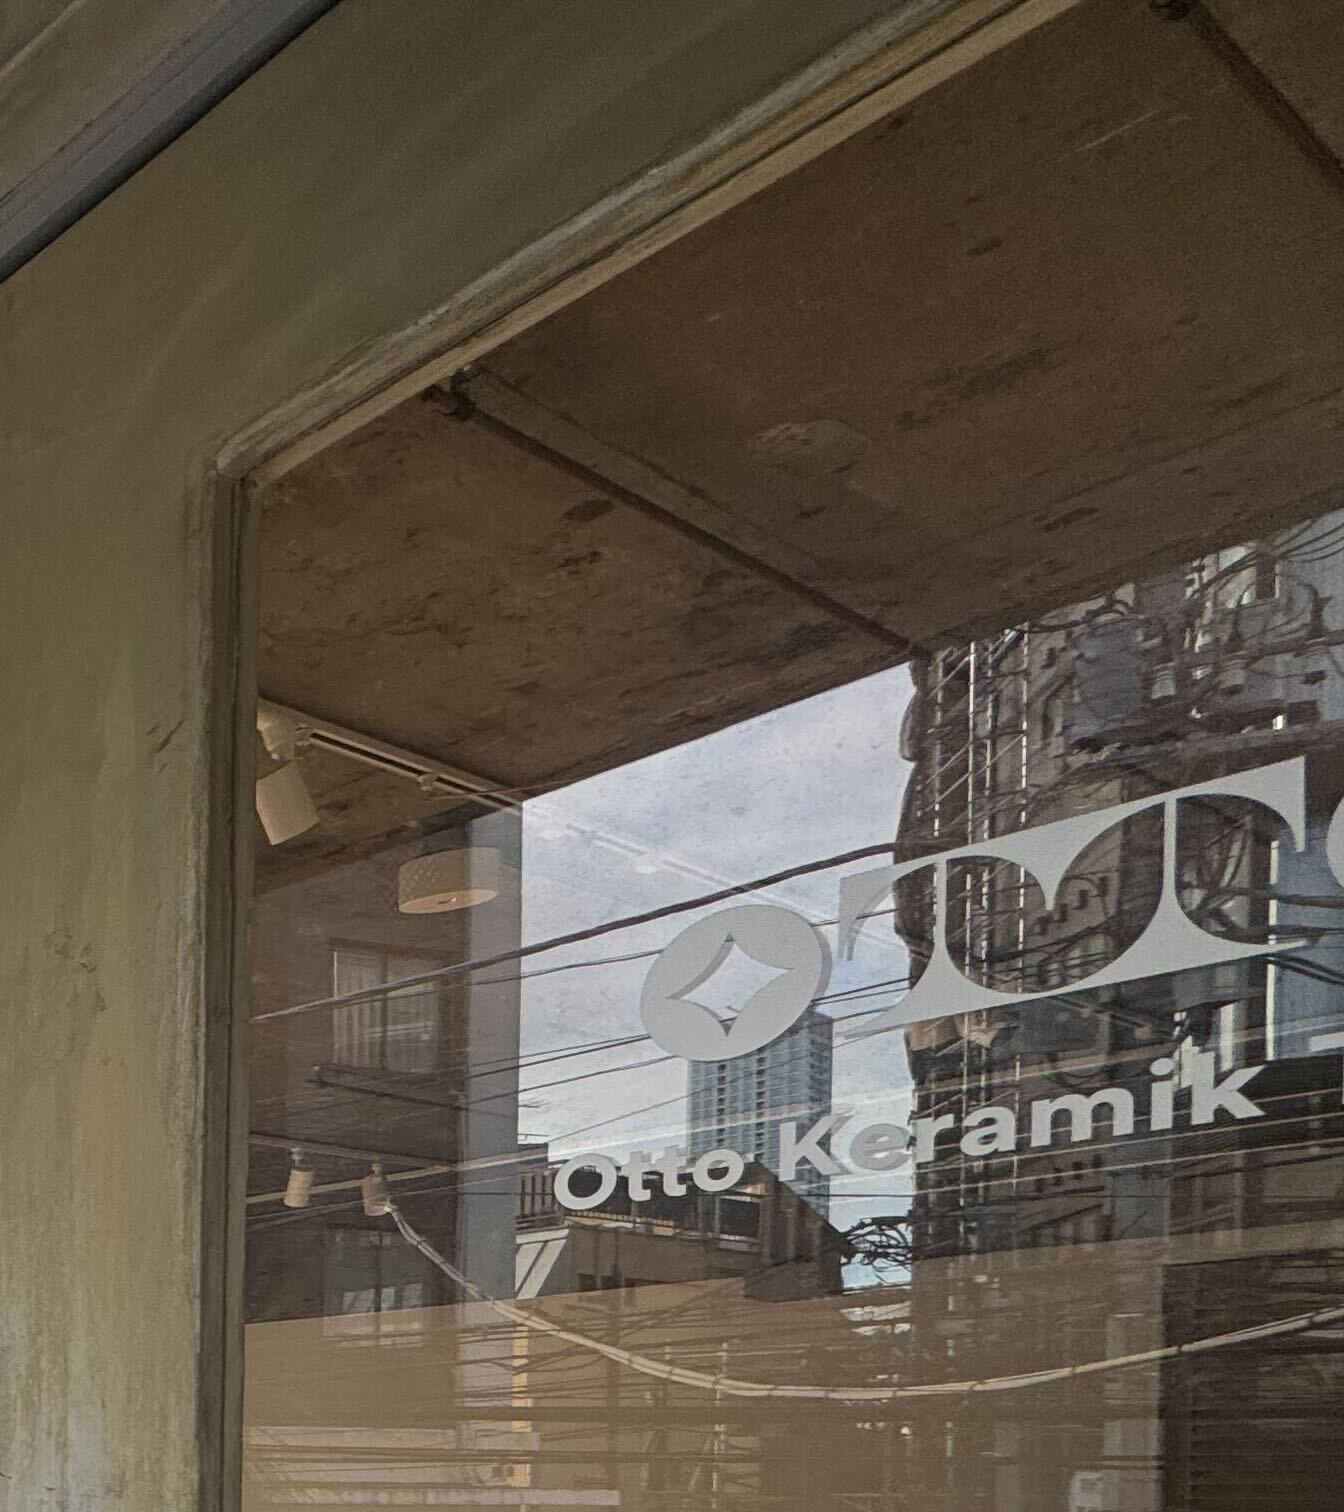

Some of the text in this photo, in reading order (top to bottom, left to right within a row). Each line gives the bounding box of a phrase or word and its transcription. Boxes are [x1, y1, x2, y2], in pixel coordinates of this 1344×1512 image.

[640, 757, 1344, 1062] OTT
[554, 1146, 744, 1210] Otto
[779, 1052, 1267, 1182] Keramik
